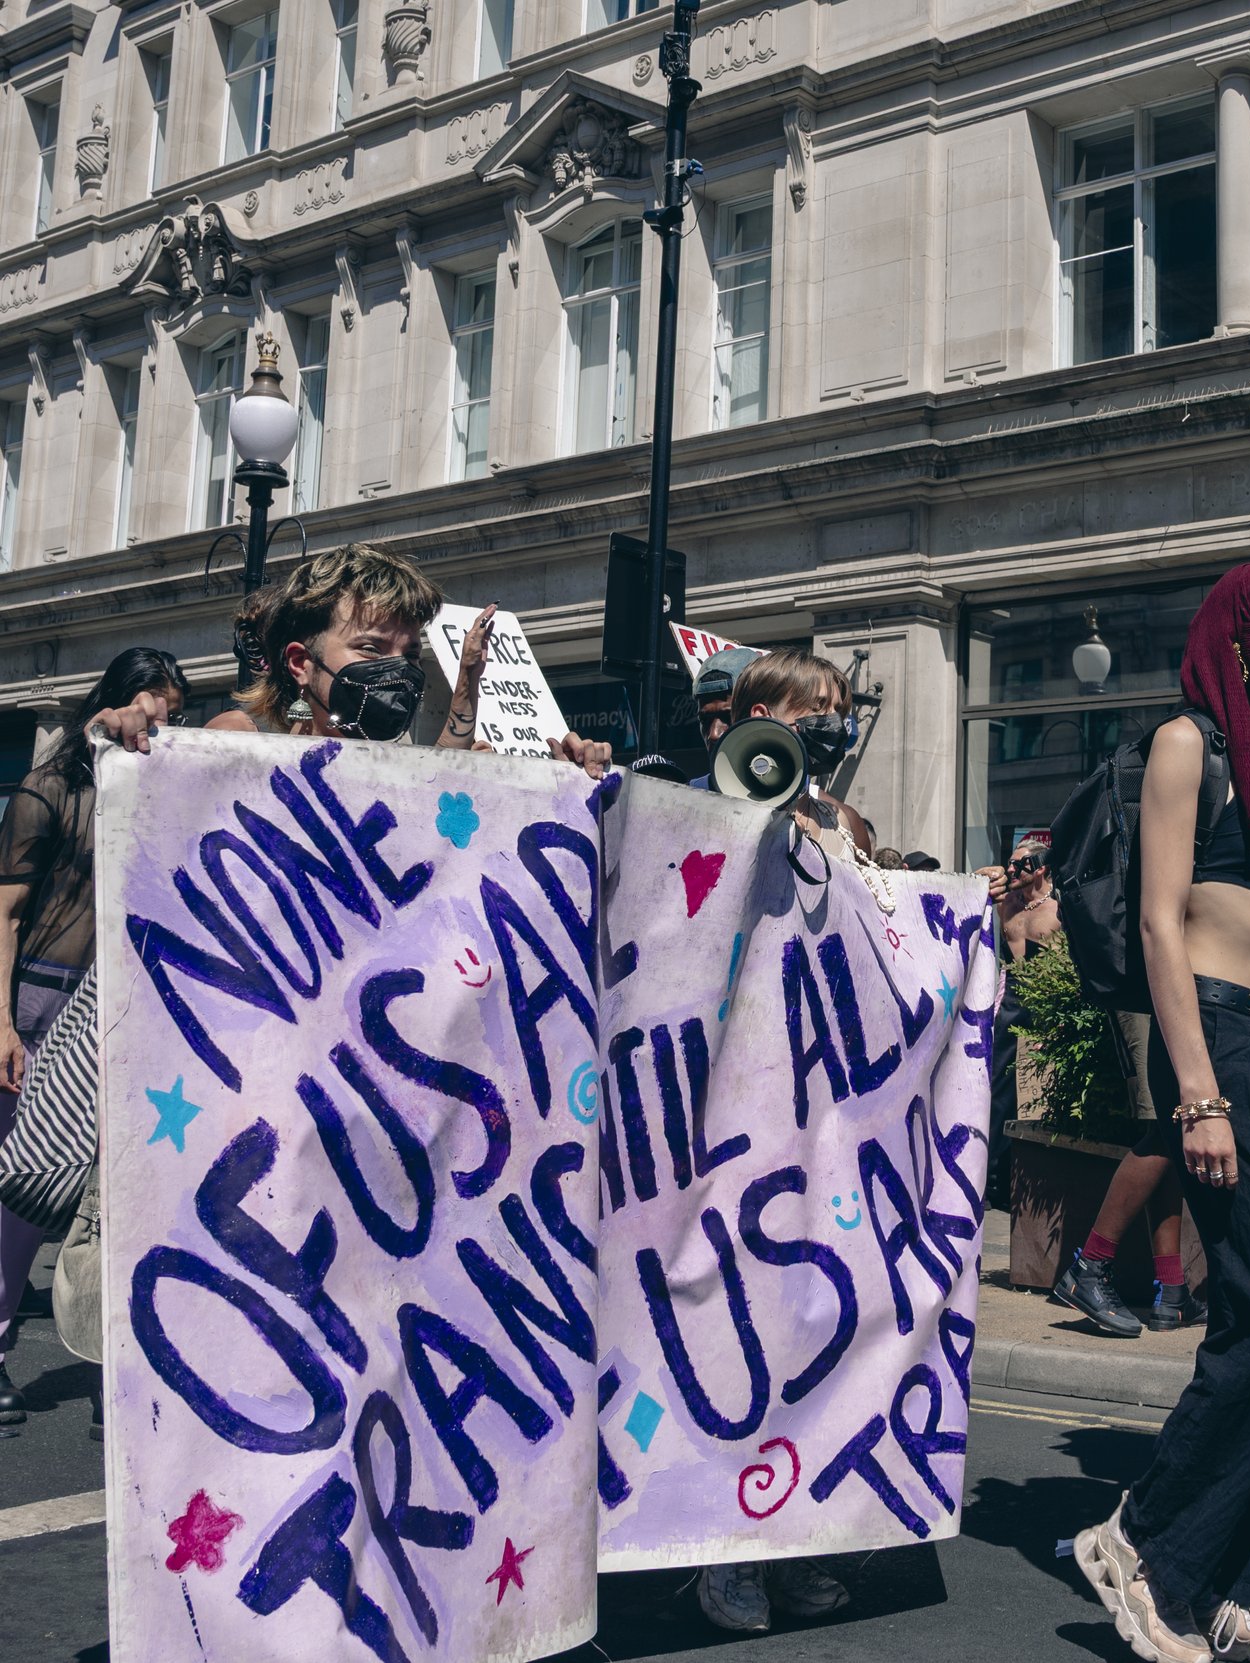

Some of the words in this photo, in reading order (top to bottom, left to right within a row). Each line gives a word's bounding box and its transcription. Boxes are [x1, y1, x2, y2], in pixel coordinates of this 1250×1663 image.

[442, 624, 532, 665] FRCE
[478, 677, 543, 701] ENDER-
[498, 700, 538, 718] NESS
[565, 710, 629, 729] armacy
[481, 721, 504, 743] IS
[513, 726, 543, 743] OUR
[126, 739, 436, 1093] NONE
[129, 1115, 369, 1456] OF
[295, 967, 511, 1259] US
[635, 1164, 859, 1442] US
